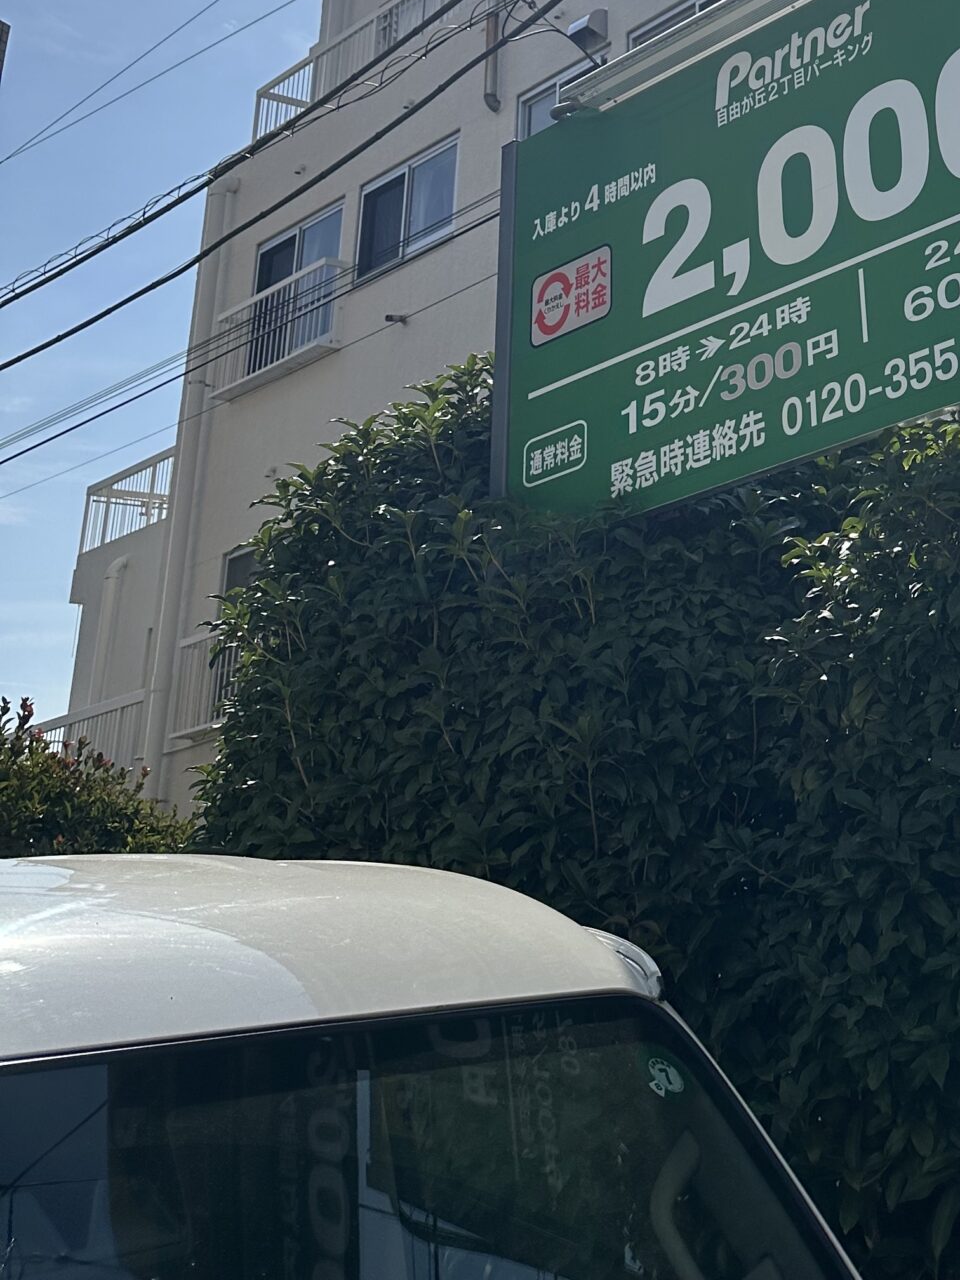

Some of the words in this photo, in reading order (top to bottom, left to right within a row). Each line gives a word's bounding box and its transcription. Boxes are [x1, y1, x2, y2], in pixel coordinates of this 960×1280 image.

[715, 0, 871, 111] Partner
[717, 32, 873, 128] 自由が丘2丁目パーキング
[575, 257, 608, 291] 最大
[575, 283, 608, 317] 料金
[621, 329, 839, 435] 15分/300円
[529, 433, 583, 477] 通常料金
[610, 411, 766, 499] 緊急時連絡先
